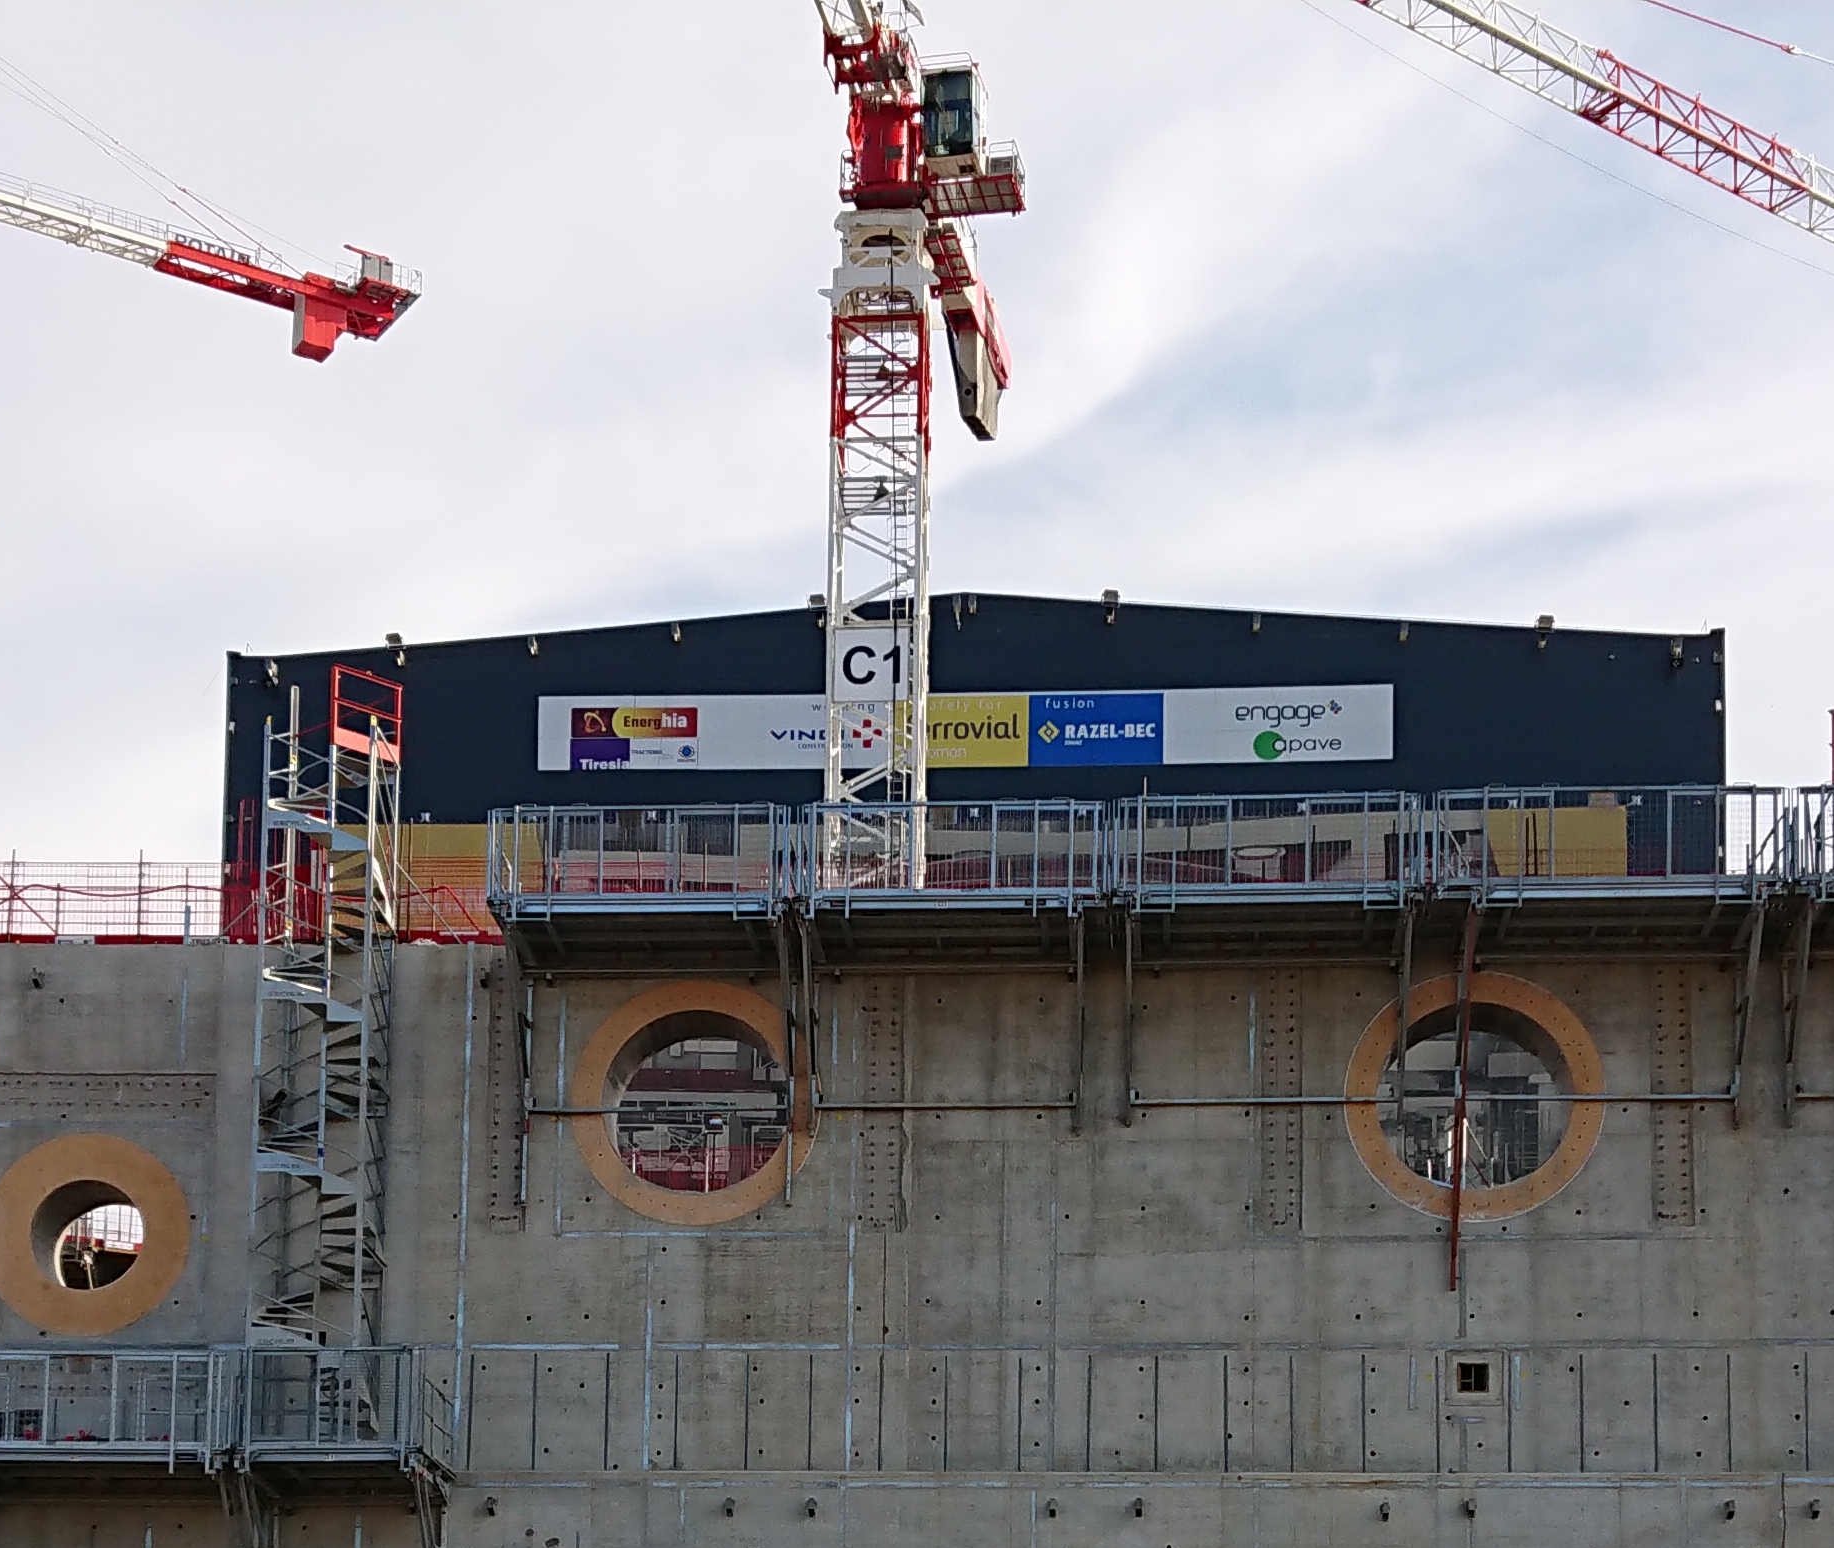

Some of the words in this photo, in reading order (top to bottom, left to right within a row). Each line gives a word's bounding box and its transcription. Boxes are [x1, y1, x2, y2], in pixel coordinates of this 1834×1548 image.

[842, 646, 900, 684] C1
[1046, 698, 1095, 709] fusion
[623, 713, 687, 731] Energhia
[1235, 704, 1326, 728] engage
[1065, 723, 1156, 739] RAZEL-BEC
[1272, 738, 1342, 753] apave
[579, 758, 630, 770] Tiresia
